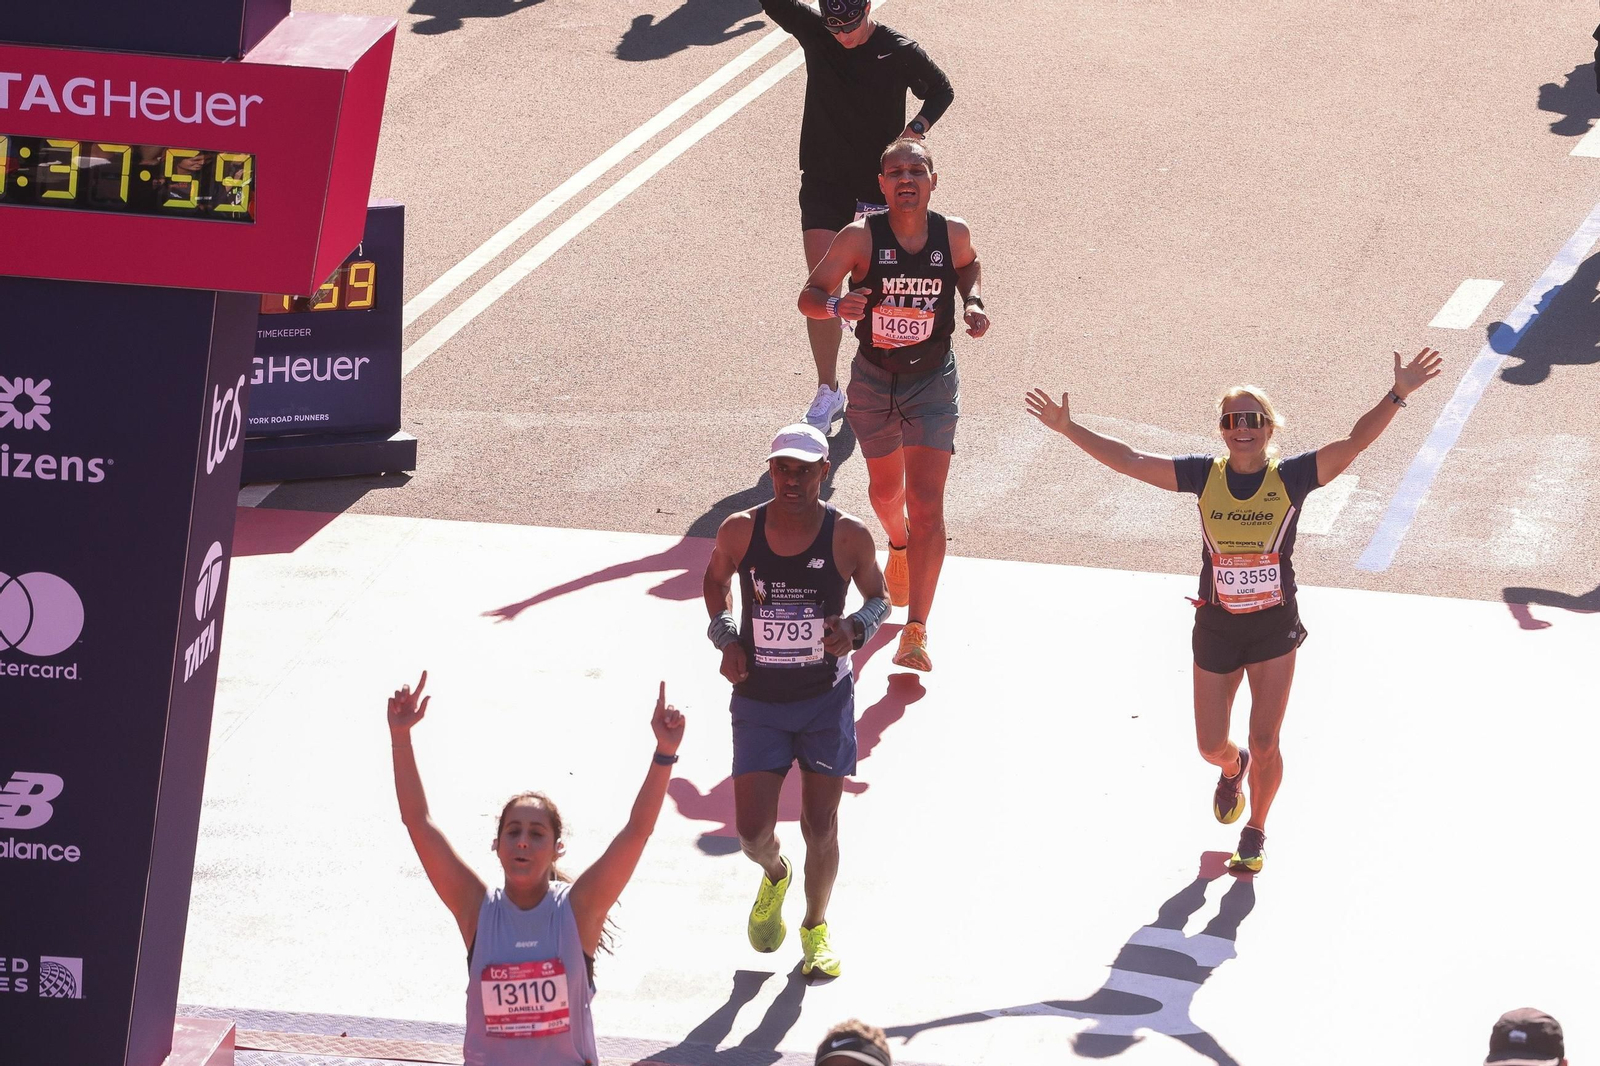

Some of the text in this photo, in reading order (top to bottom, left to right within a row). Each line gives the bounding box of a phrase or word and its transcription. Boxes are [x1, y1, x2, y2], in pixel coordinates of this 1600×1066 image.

[882, 273, 943, 296] MÉXICO
[881, 295, 939, 312] ALEX
[878, 316, 928, 336] 14661
[257, 328, 312, 339] TIMEKEEPER
[885, 332, 920, 341] ALEJANDRO
[206, 374, 246, 475] tcs
[248, 413, 330, 425] YORK ROAD RUNNERS
[1210, 509, 1274, 521] la foulée
[1219, 556, 1233, 566] tcs
[1216, 567, 1277, 585] AG 3559
[760, 608, 775, 618] tcs
[763, 621, 813, 642] 5793
[184, 618, 215, 683] TATA
[490, 967, 507, 979] tcs
[492, 980, 556, 1006] 13110
[508, 1005, 544, 1013] DANIELLE
